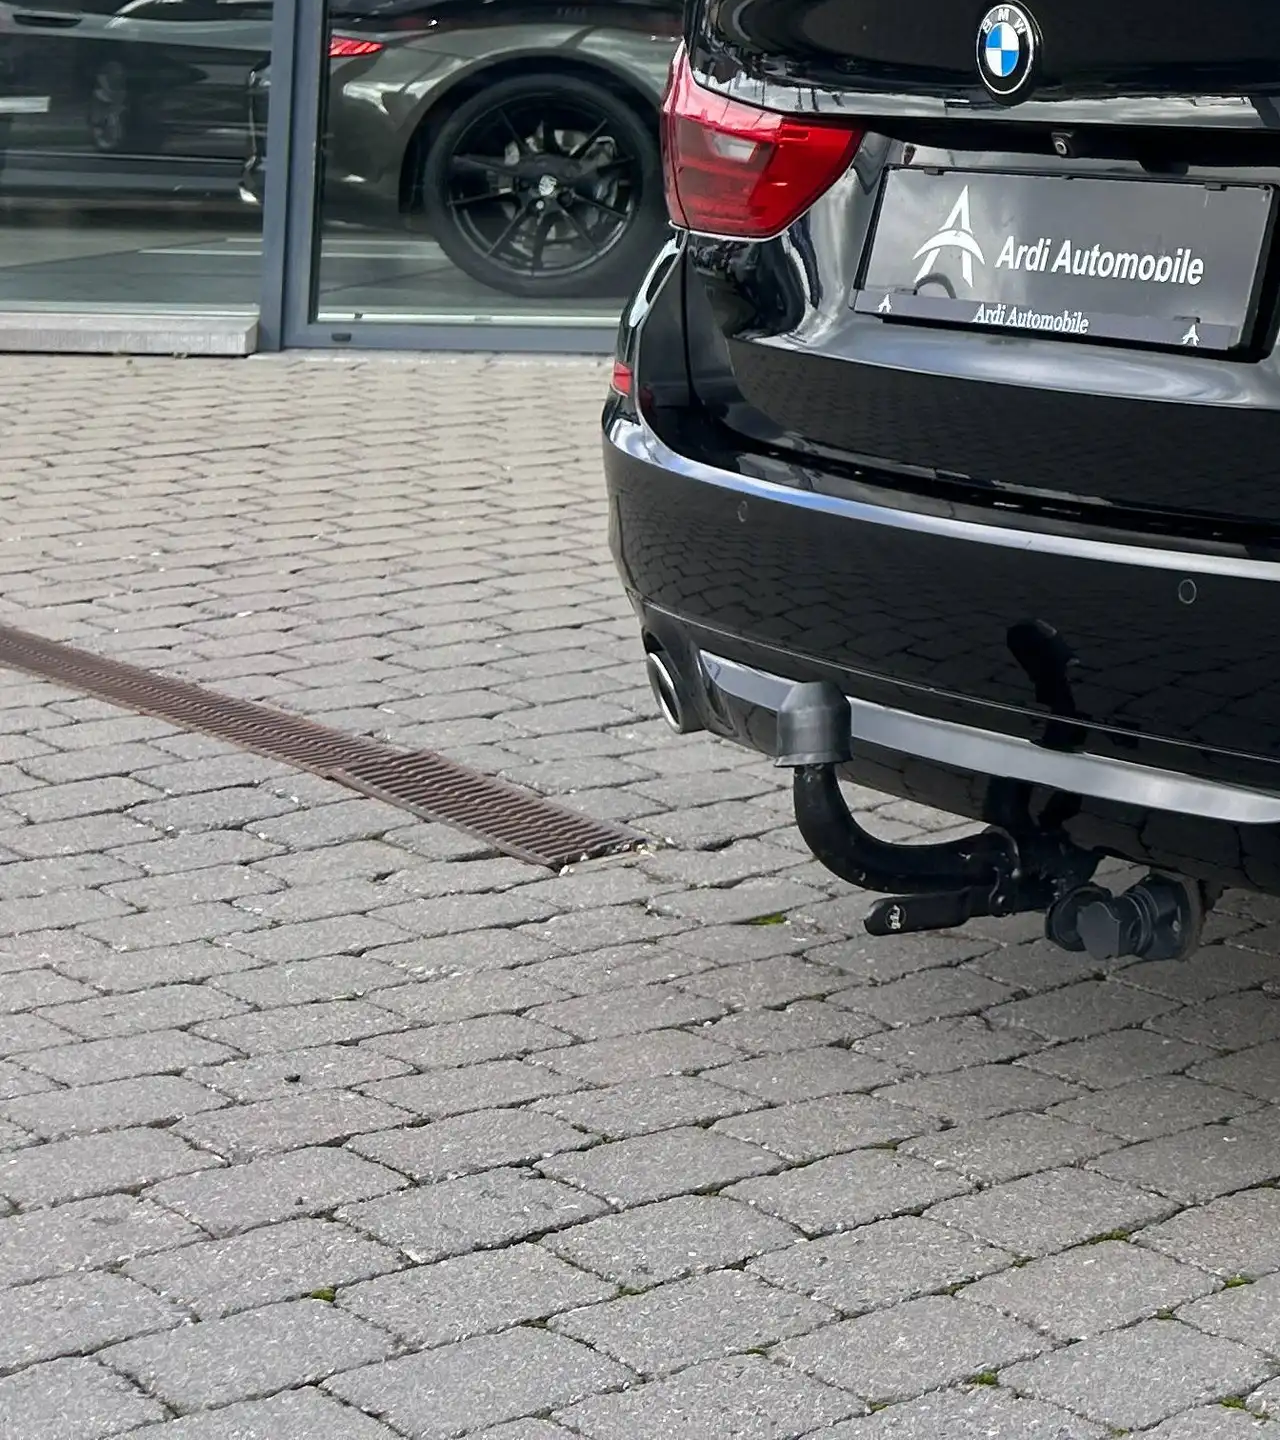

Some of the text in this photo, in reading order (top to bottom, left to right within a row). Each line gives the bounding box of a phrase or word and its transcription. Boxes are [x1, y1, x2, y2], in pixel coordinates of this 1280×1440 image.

[982, 7, 1027, 36] BMW
[995, 234, 1204, 285] Ardi Automobile
[973, 304, 1089, 334] Ardi Automobile
